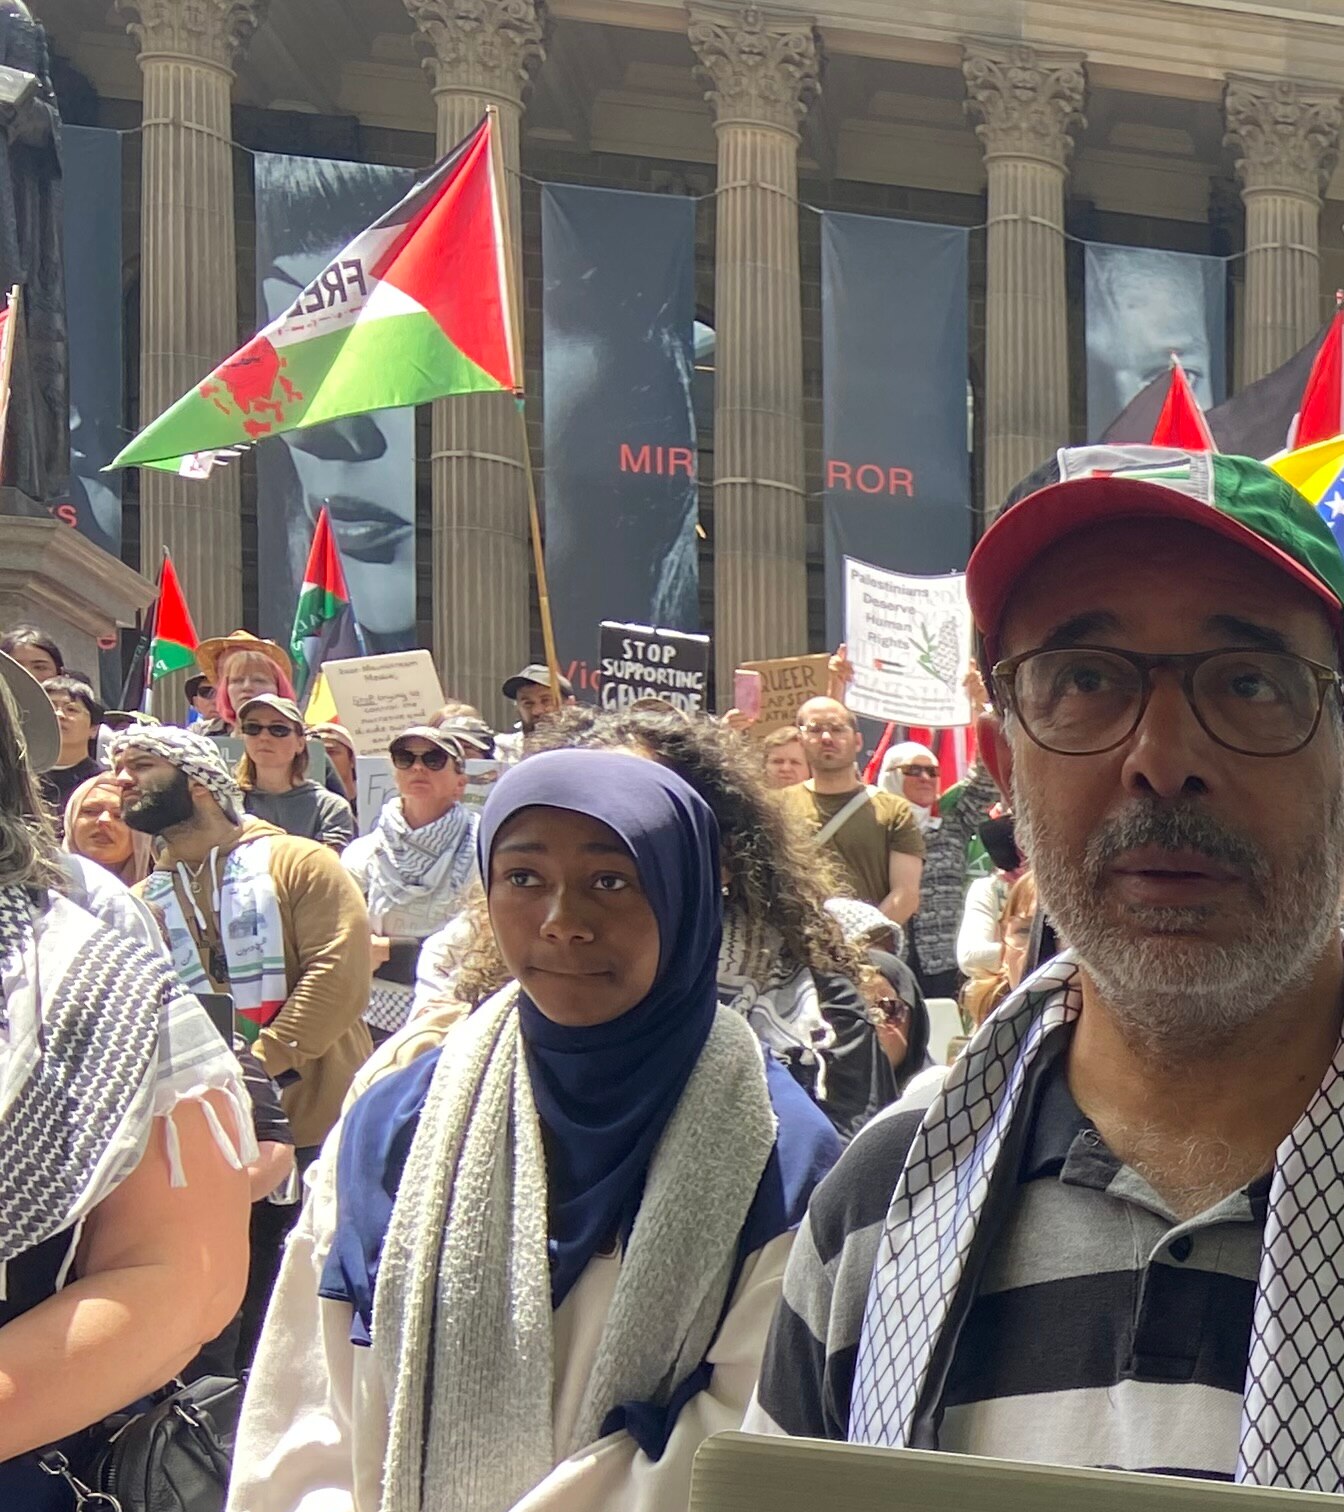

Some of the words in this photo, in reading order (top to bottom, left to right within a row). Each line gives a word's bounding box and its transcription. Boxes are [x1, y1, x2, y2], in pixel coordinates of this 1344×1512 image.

[826, 460, 914, 497] ROR
[851, 569, 929, 597] Palestinians
[863, 592, 915, 615] Deserve
[865, 613, 912, 632] Human
[622, 638, 677, 664] STOP
[867, 631, 910, 650] Rights
[601, 658, 704, 691] SUPPORTING
